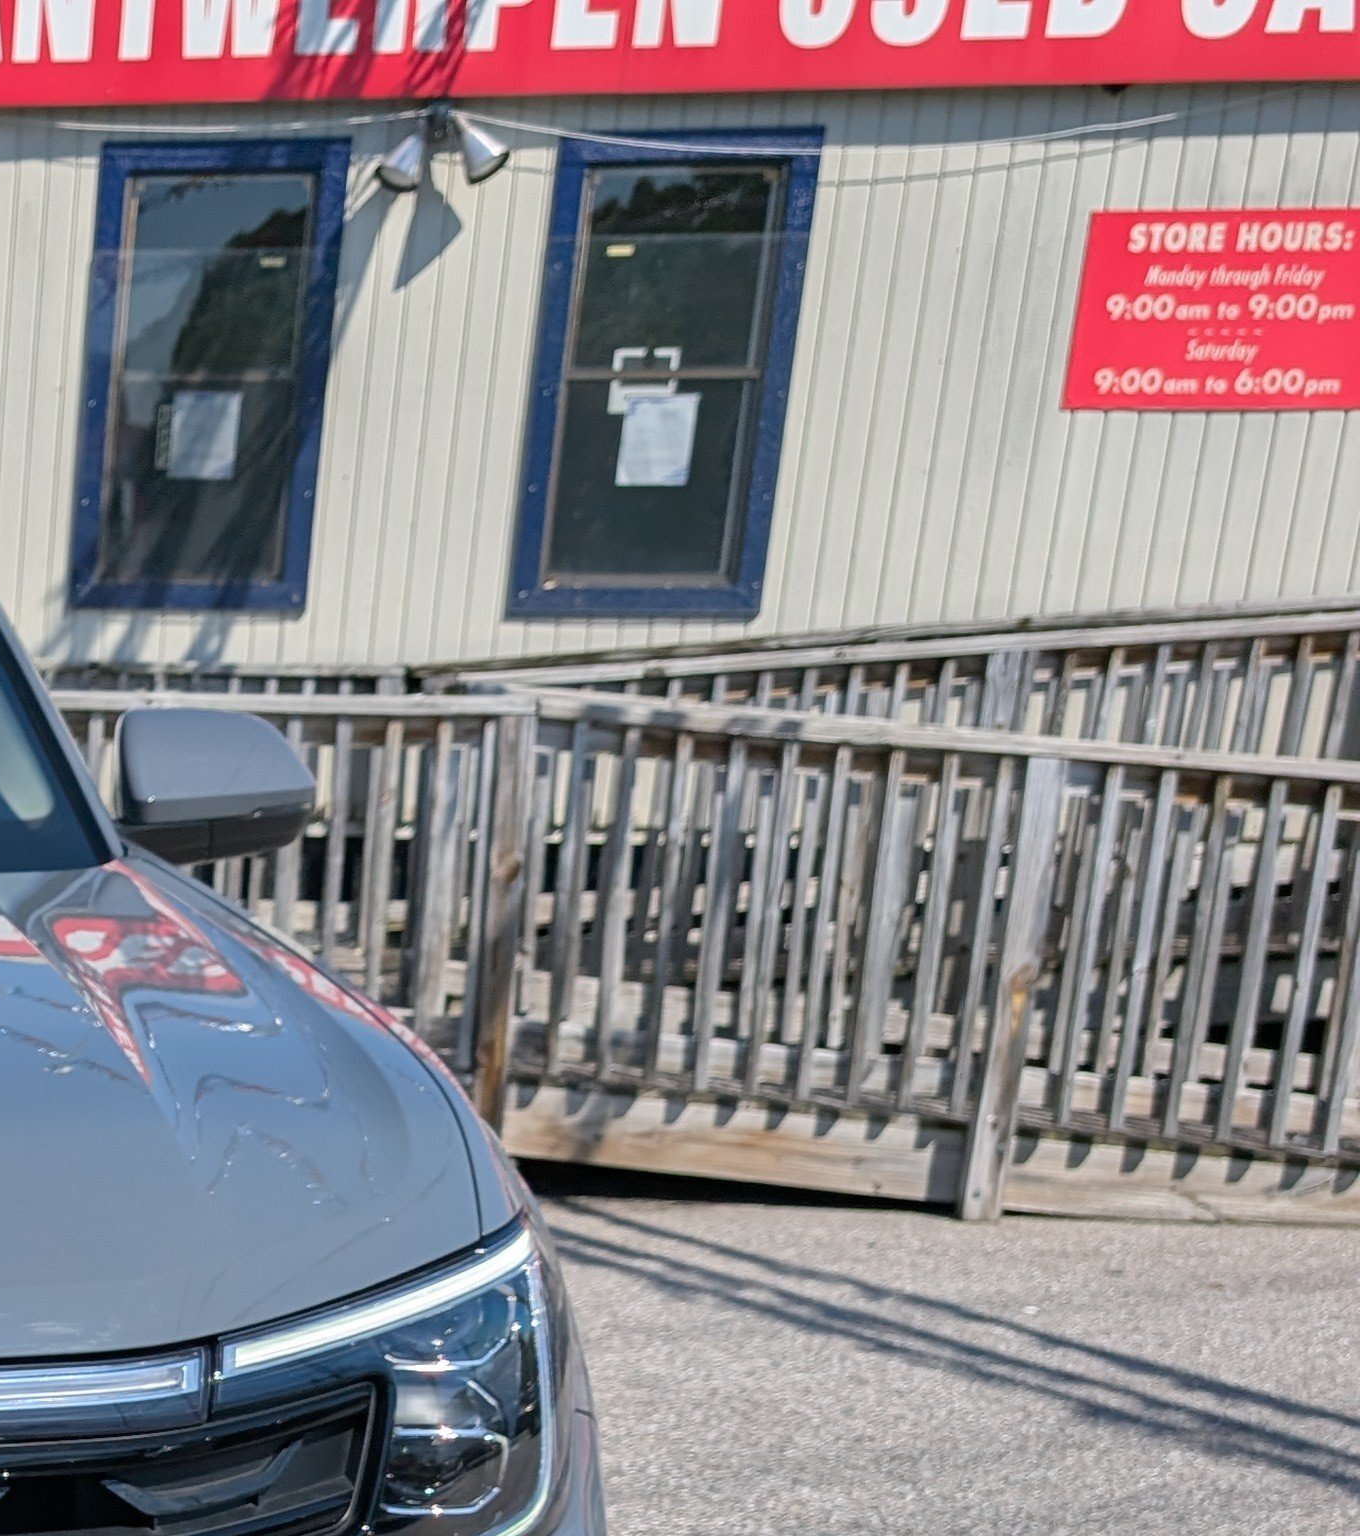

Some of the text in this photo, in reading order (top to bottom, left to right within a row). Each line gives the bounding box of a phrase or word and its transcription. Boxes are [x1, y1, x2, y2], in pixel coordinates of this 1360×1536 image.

[1127, 221, 1356, 253] STORE HOURS:
[1143, 264, 1325, 290] Monday through Friday
[1217, 302, 1241, 321] to
[1185, 339, 1260, 365] Saturday
[1204, 376, 1228, 395] to
